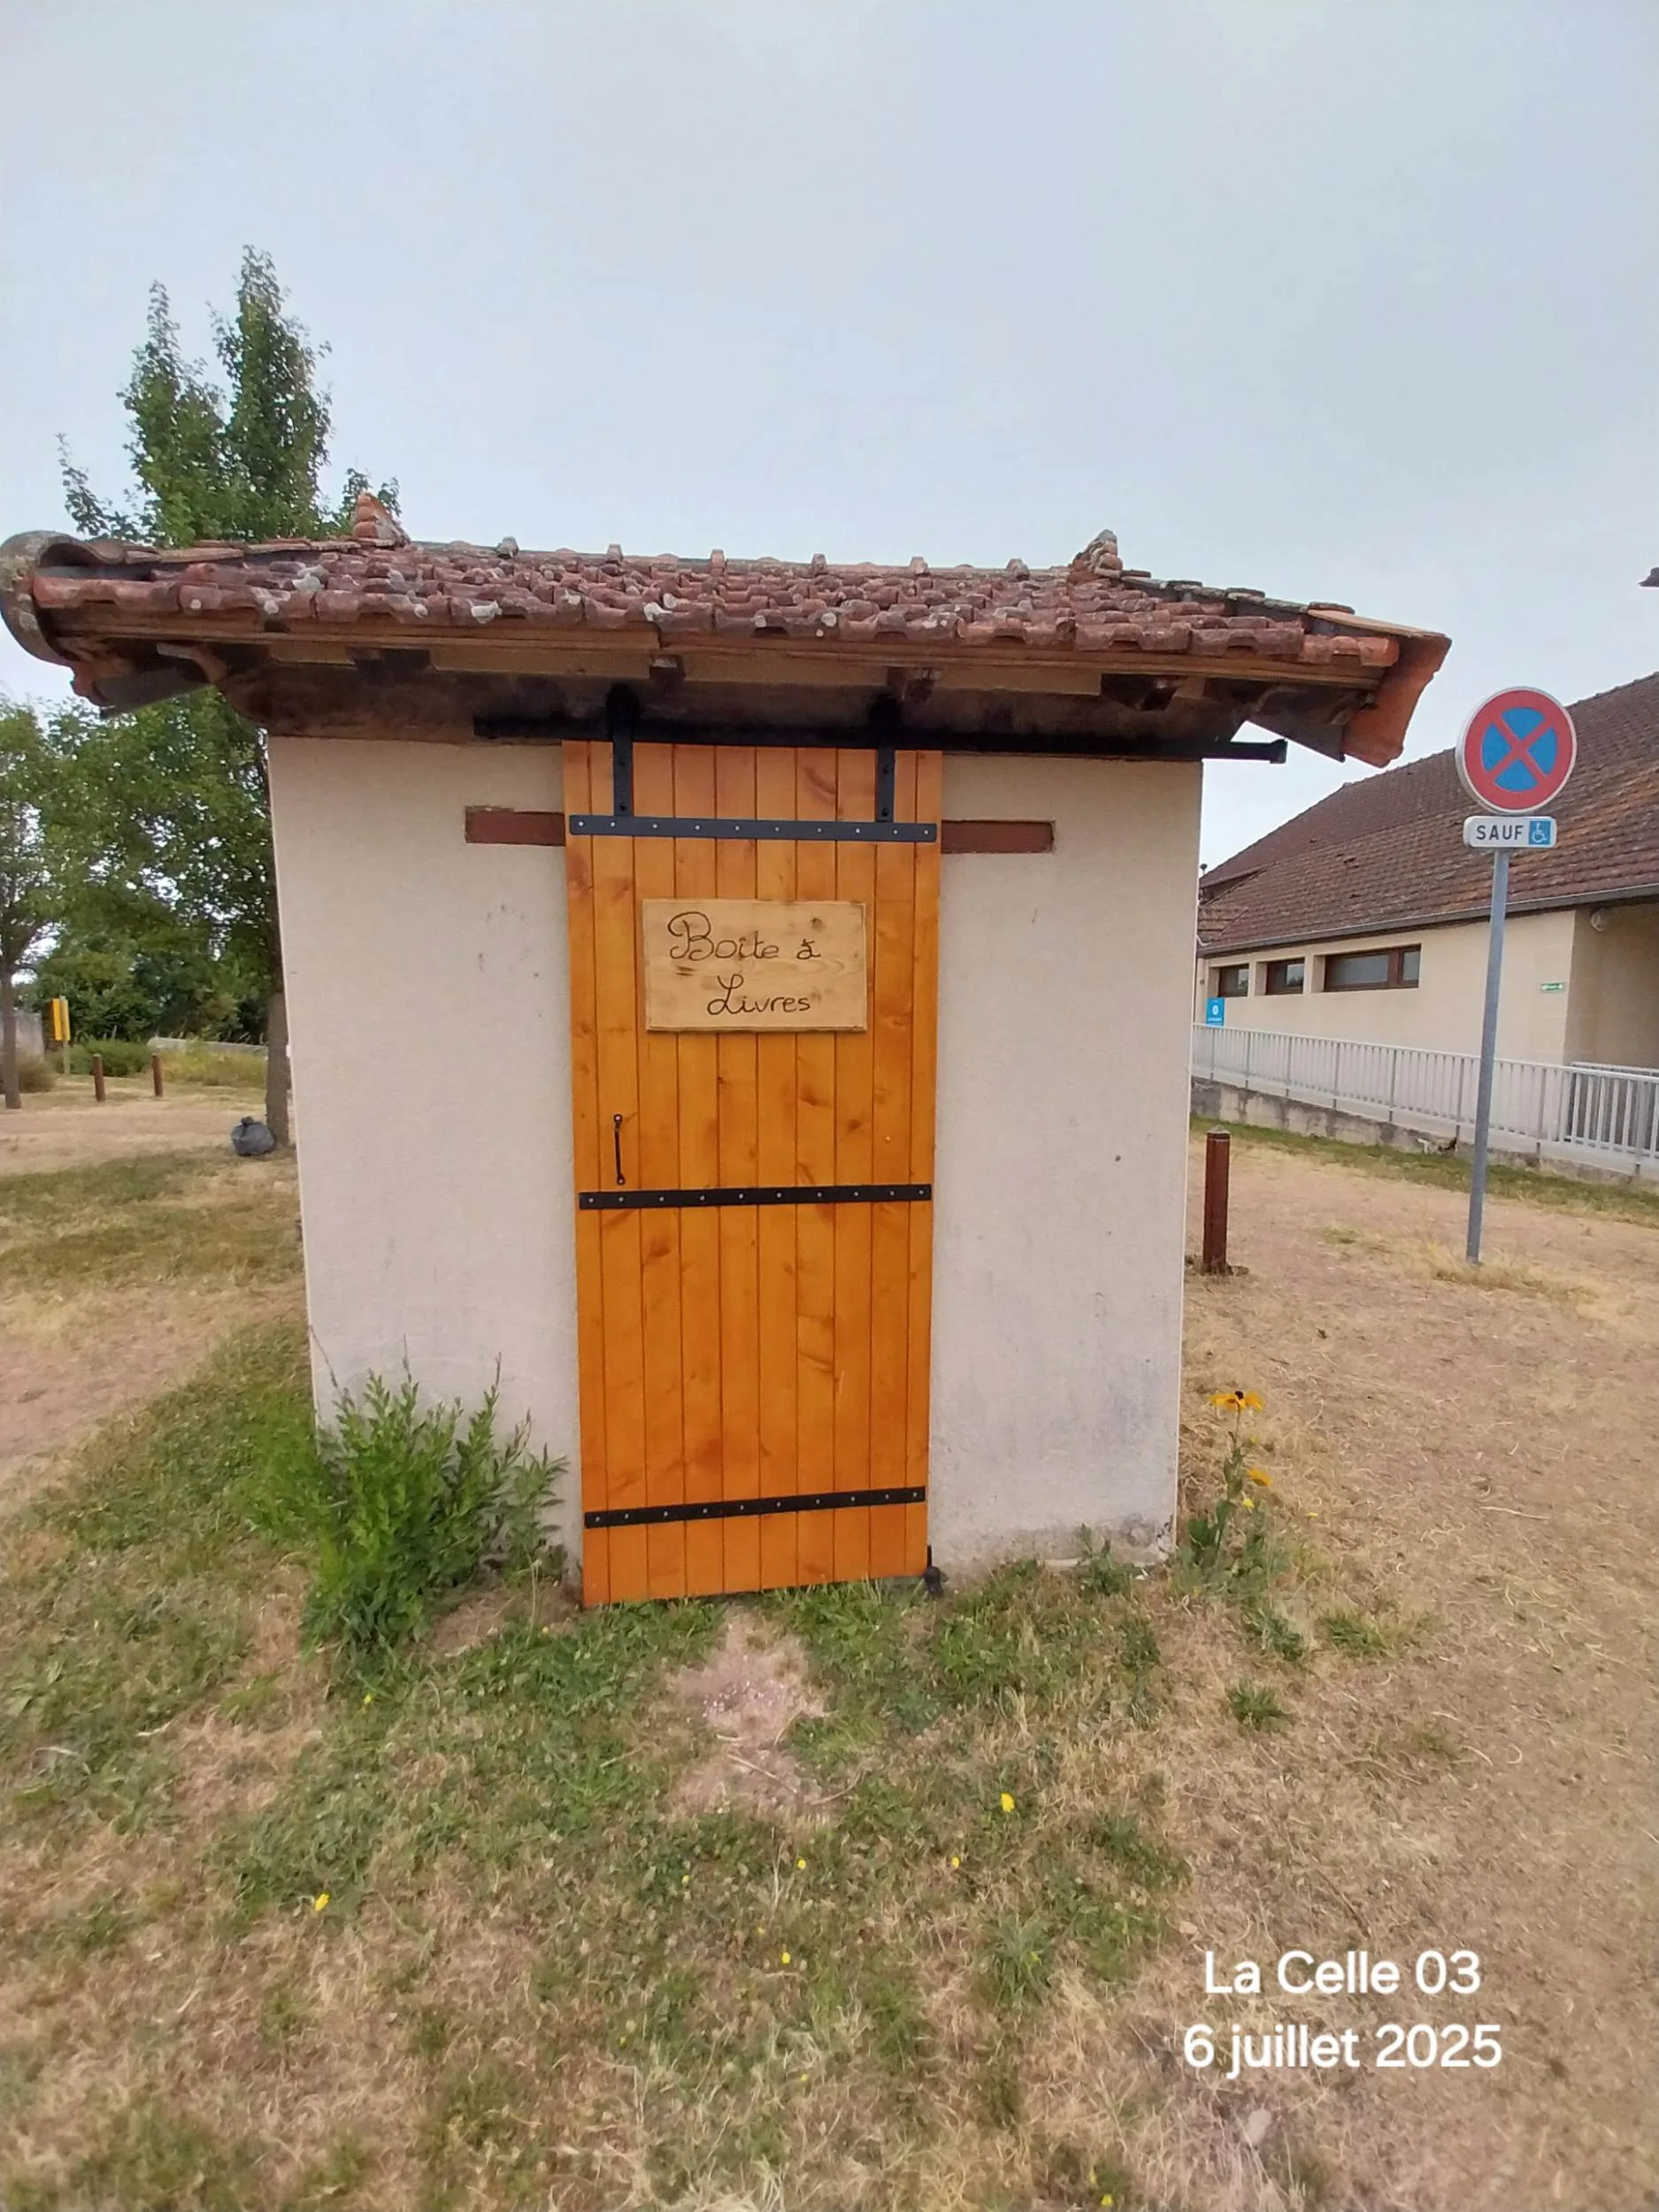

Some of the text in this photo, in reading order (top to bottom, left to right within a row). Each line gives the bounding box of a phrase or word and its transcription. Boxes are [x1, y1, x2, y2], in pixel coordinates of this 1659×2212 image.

[1475, 825, 1524, 841] SAUF
[796, 938, 821, 960] à
[707, 973, 811, 1015] Livres
